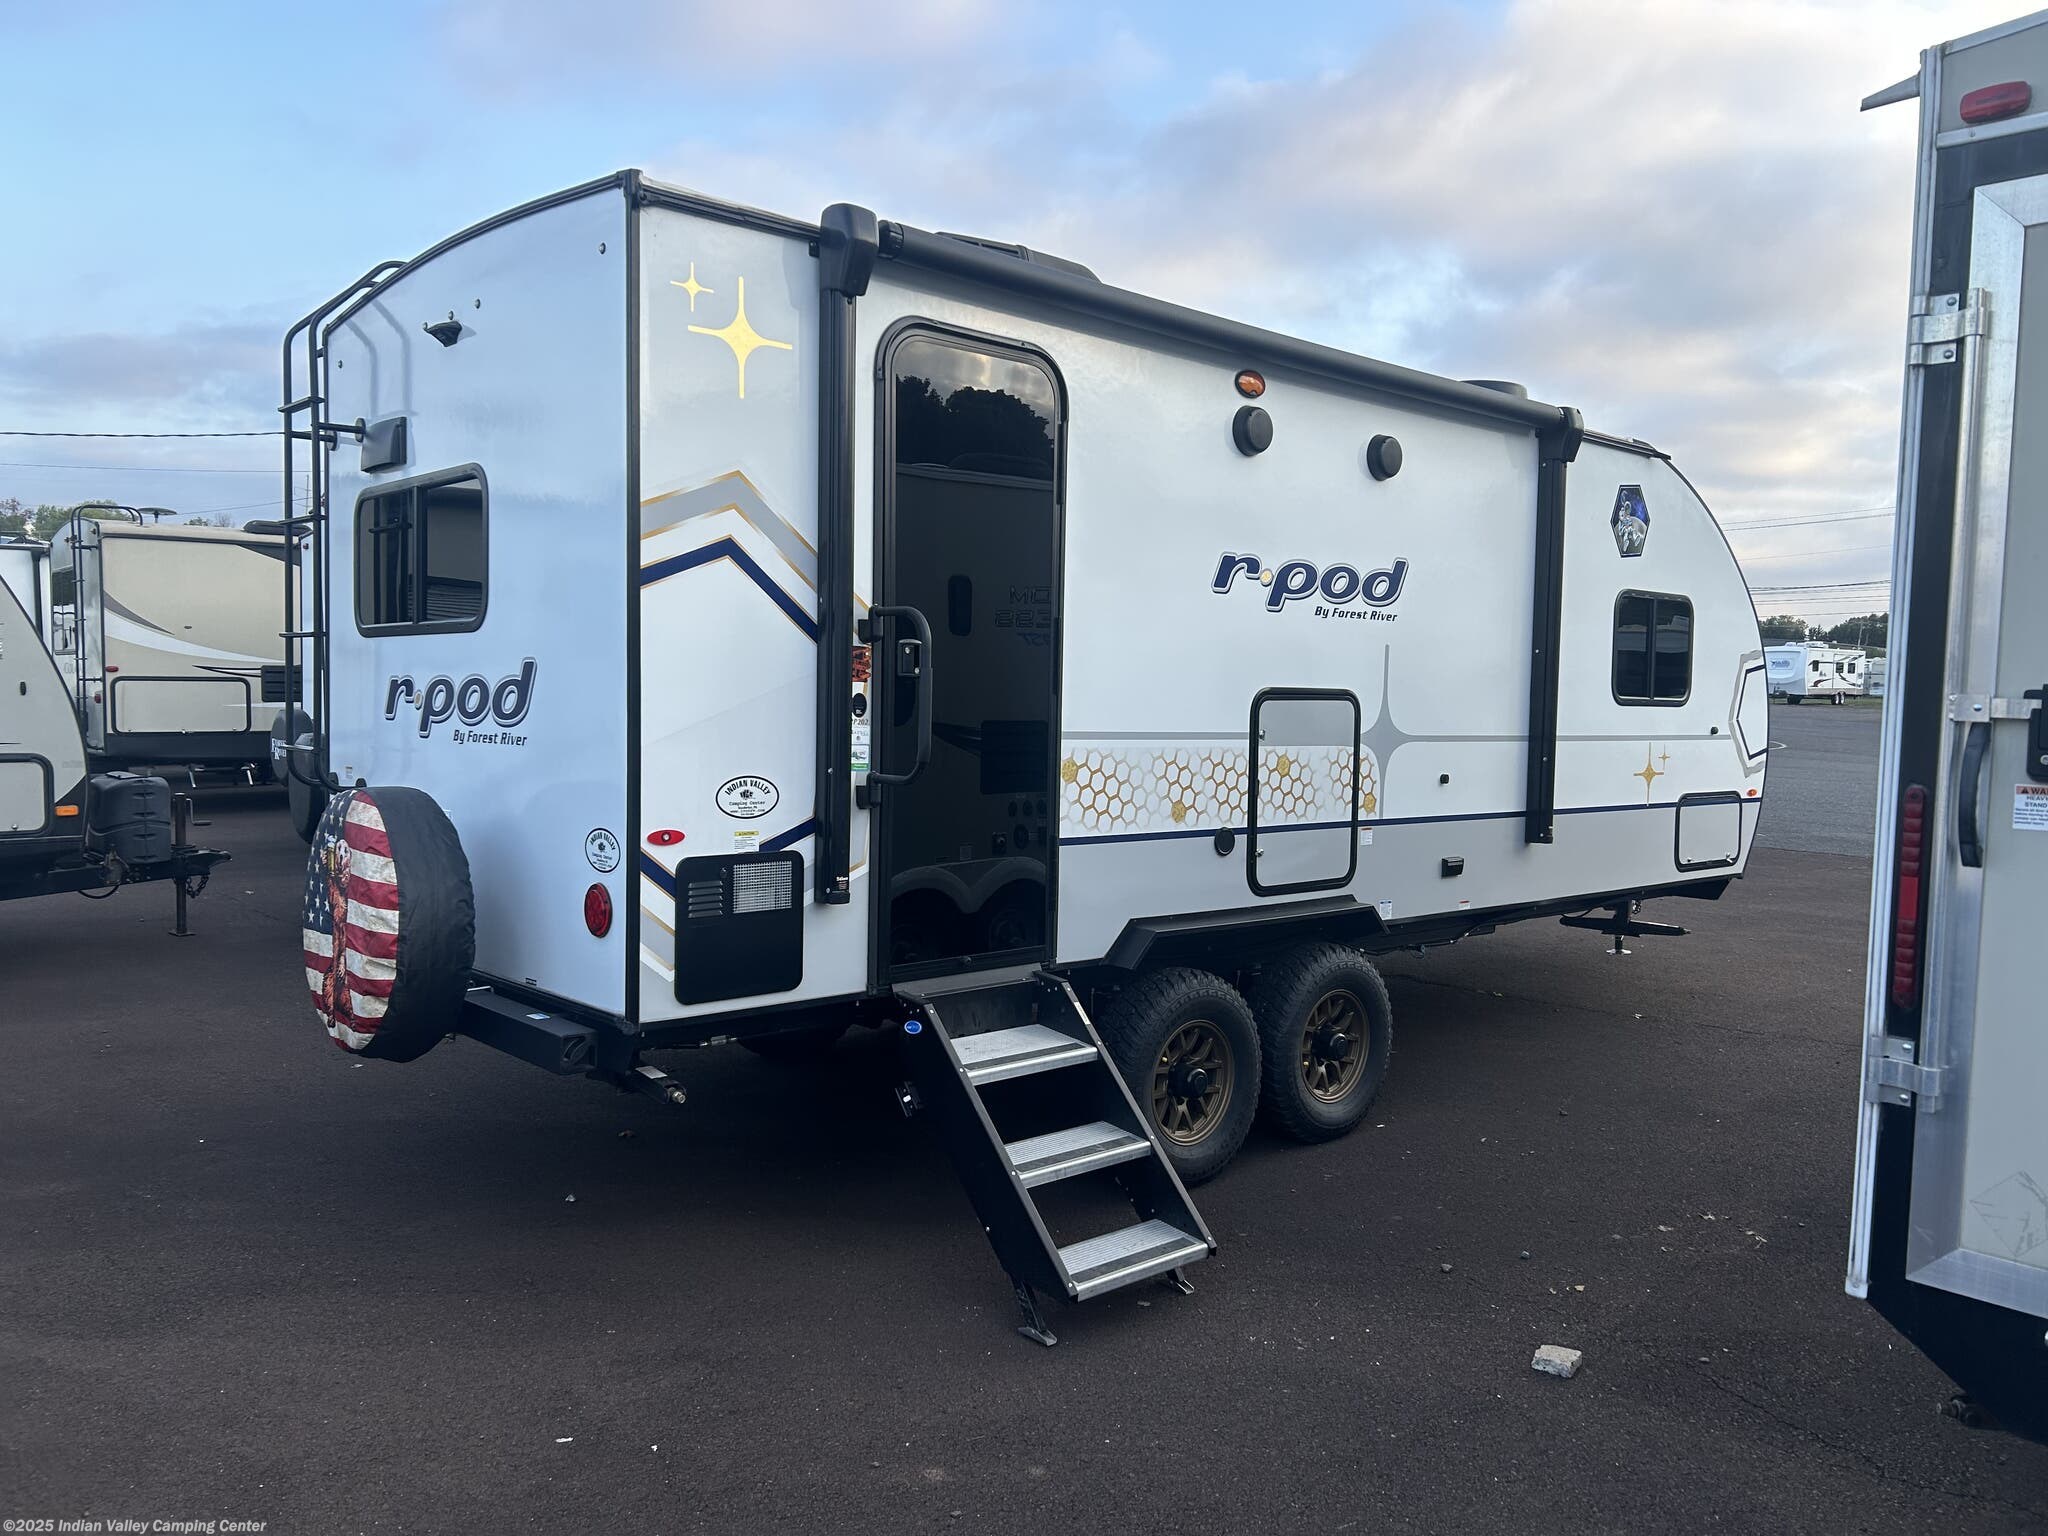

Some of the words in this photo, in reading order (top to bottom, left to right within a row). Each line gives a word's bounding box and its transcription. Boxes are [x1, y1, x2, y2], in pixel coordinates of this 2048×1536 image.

[1314, 606, 1329, 619] By
[1332, 607, 1368, 620] Forest
[1370, 610, 1398, 622] River
[453, 729, 465, 744] By
[467, 730, 498, 744] Forest
[500, 732, 527, 746] River
[724, 779, 748, 796] INDIAN
[750, 779, 771, 795] VALLEY
